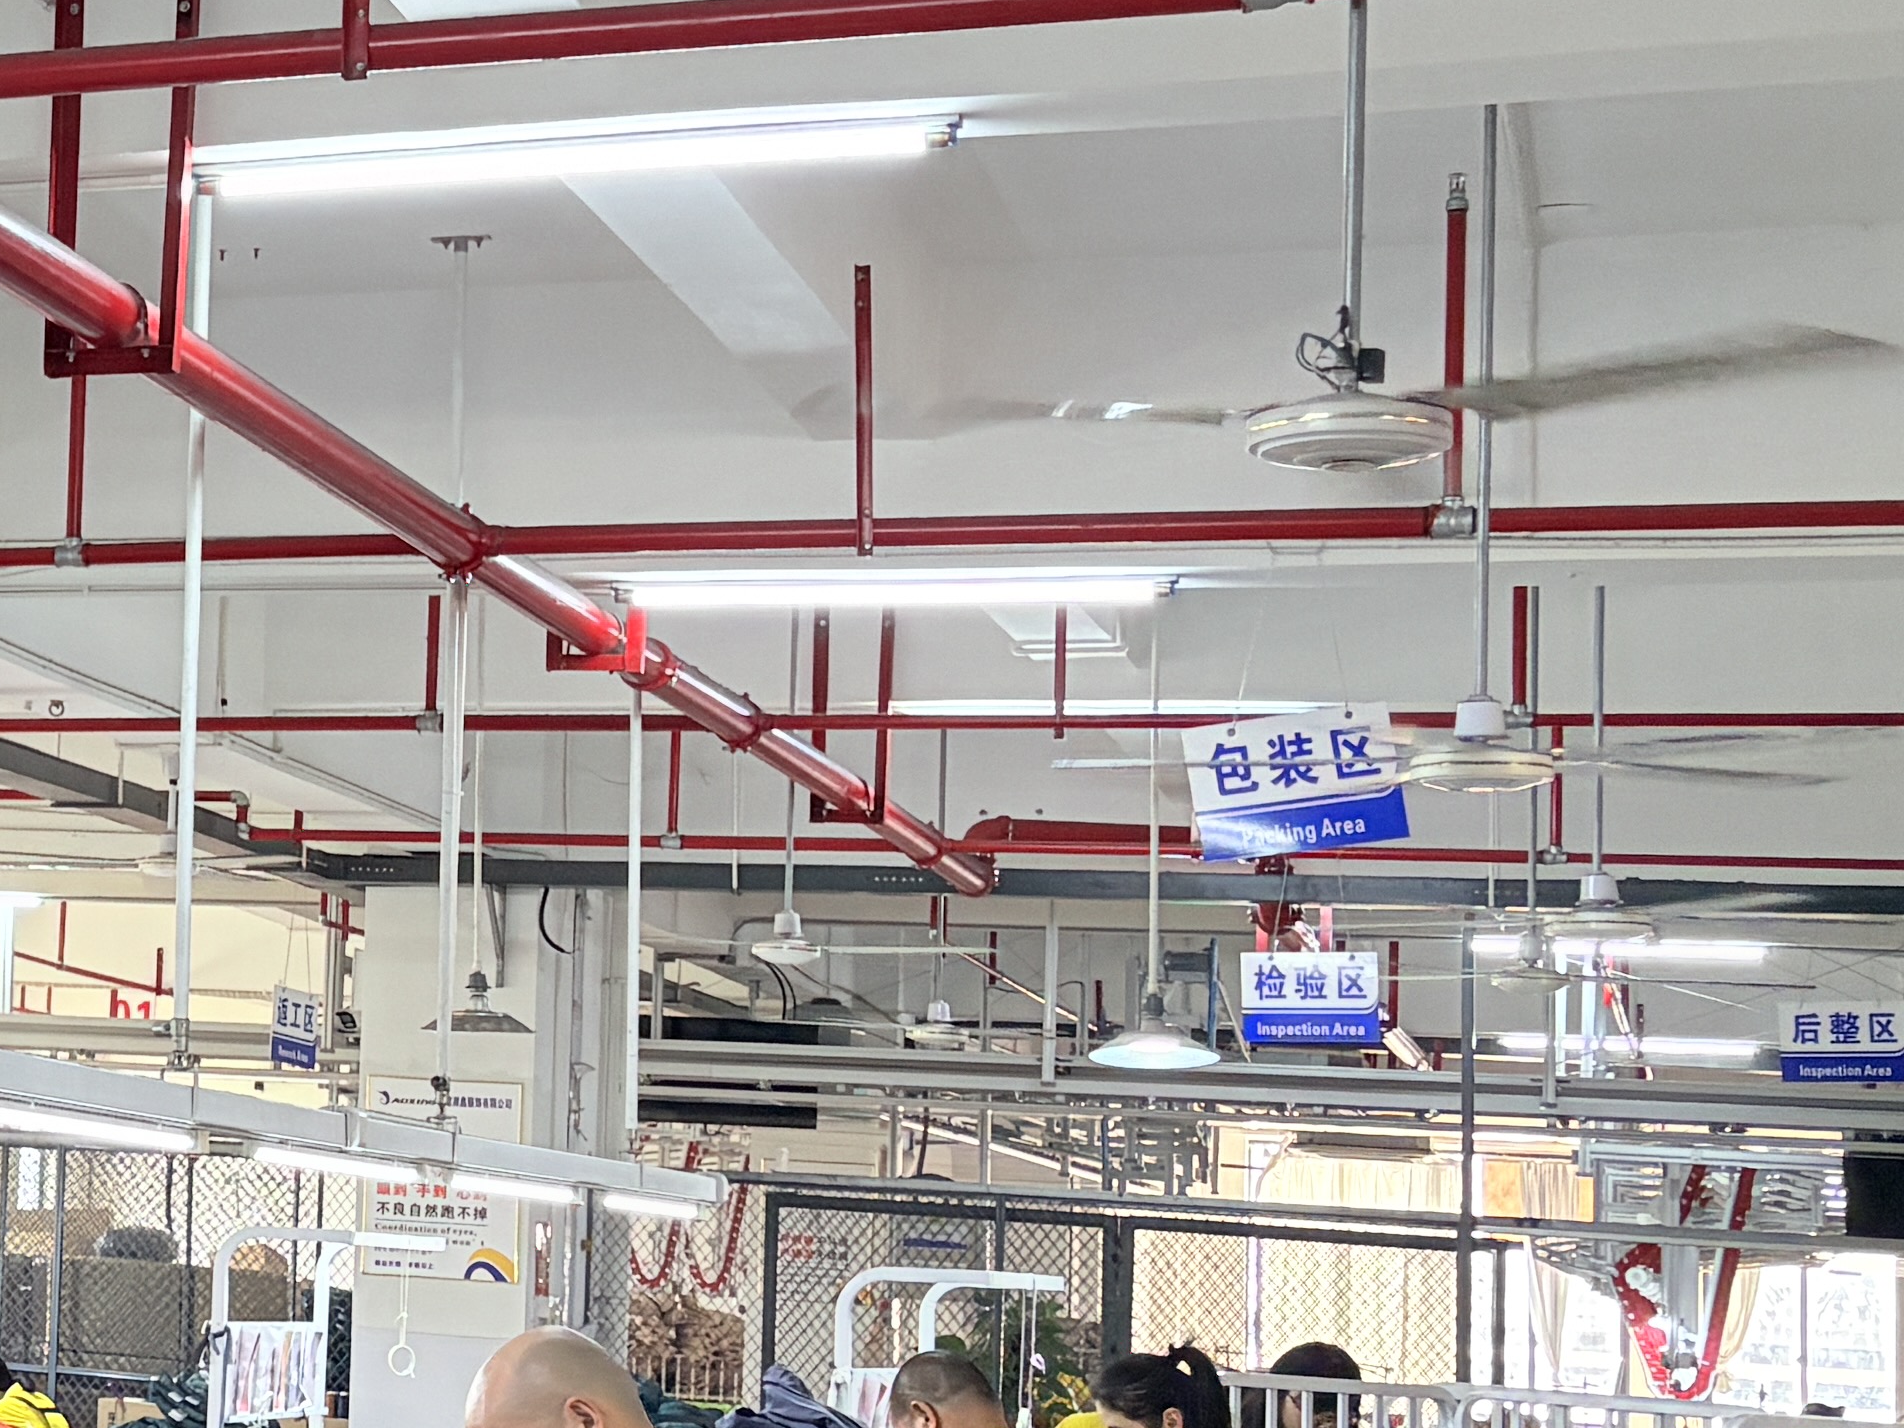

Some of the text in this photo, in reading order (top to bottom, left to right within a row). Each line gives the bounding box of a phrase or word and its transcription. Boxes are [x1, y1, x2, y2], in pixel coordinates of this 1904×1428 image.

[1207, 727, 1382, 796] 包装区
[1241, 817, 1366, 848] Packing Area
[1254, 964, 1367, 1000] 检验区
[277, 996, 315, 1034] 返工区
[1257, 1022, 1366, 1038] Inspection Area
[1792, 1012, 1898, 1045] 后整区
[1799, 1064, 1893, 1079] Inspection Area
[376, 1201, 489, 1221] 不良自然跑不掉
[375, 1223, 478, 1237] Coordination of eyes,
